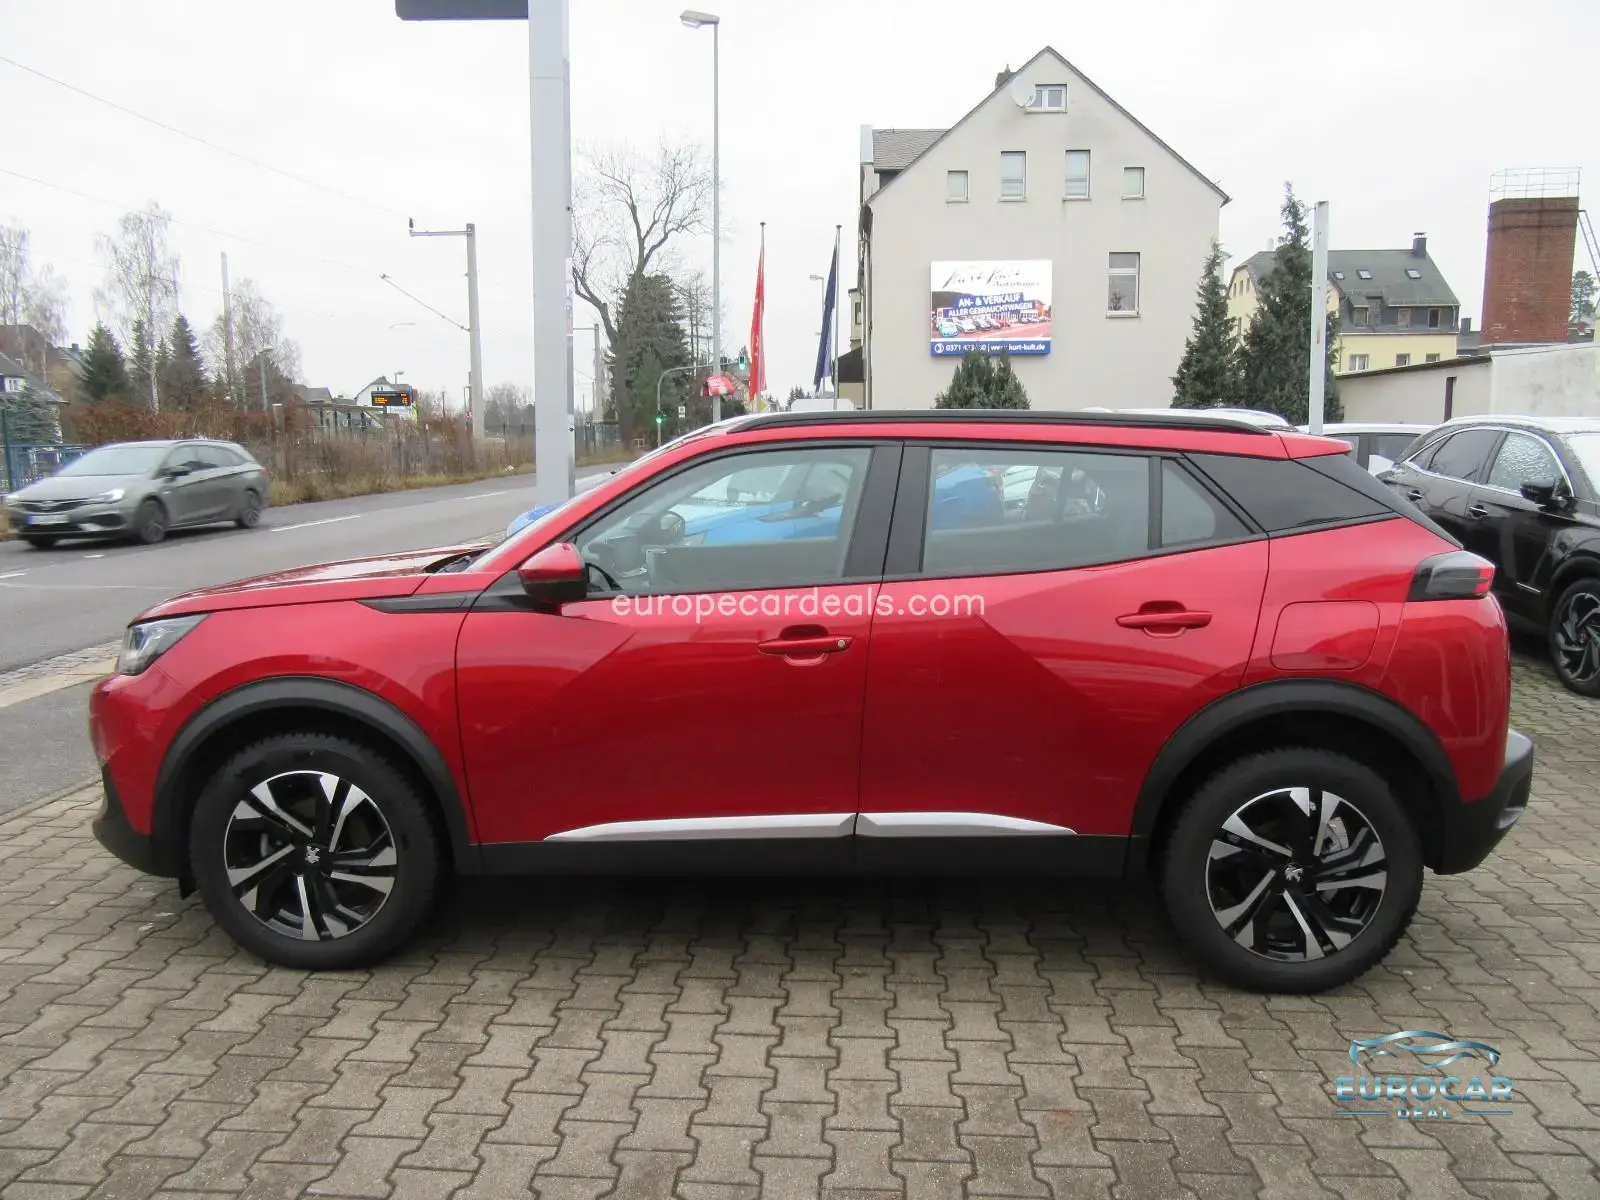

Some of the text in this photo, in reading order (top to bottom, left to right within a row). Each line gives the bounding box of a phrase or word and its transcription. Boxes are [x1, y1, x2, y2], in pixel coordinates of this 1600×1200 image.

[958, 293, 1021, 307] AN- & VERKAUF
[948, 302, 1033, 317] ALLER GEBRAUCHTWAGEN
[945, 344, 961, 352] 0371
[990, 342, 1046, 352] wwkurt-kult.de
